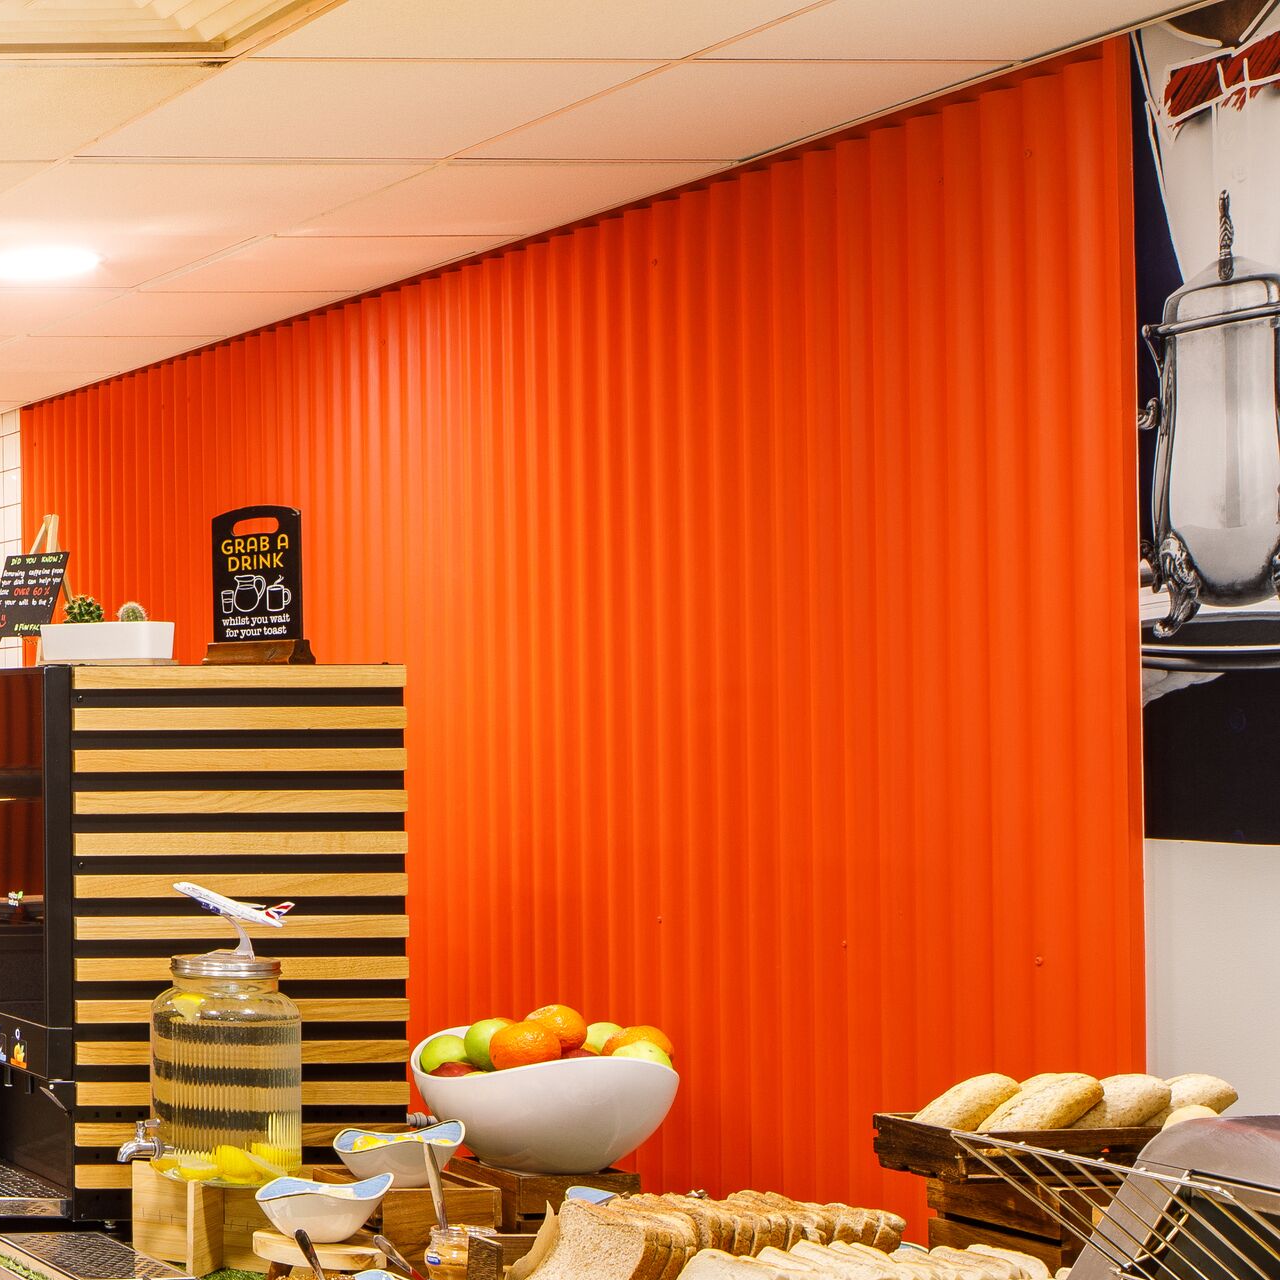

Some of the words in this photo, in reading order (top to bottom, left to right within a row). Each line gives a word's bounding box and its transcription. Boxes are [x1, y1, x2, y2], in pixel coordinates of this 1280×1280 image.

[221, 535, 270, 555] GRAB
[277, 533, 289, 550] A
[11, 557, 22, 566] DID
[227, 552, 284, 572] DRINK
[13, 587, 30, 596] OVER
[222, 615, 251, 627] whilst
[250, 615, 269, 627] you
[270, 613, 291, 623] wait
[225, 628, 239, 638] for
[240, 627, 262, 639] your
[263, 625, 287, 635] toast
